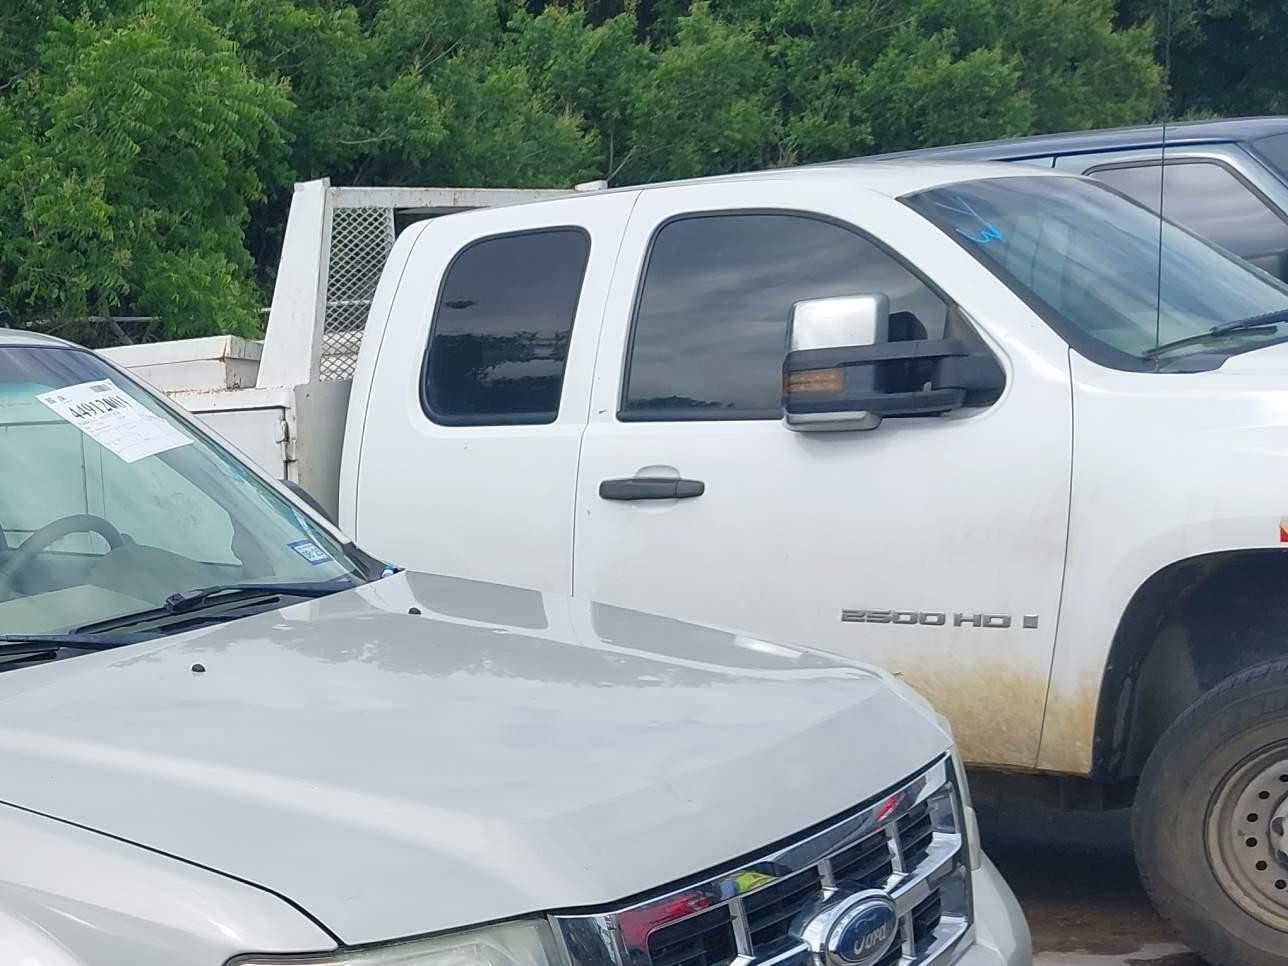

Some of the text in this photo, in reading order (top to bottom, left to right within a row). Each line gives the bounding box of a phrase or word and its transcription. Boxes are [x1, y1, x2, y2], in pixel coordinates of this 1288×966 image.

[841, 608, 1012, 628] 2500 HD
[854, 912, 887, 955] Ford
